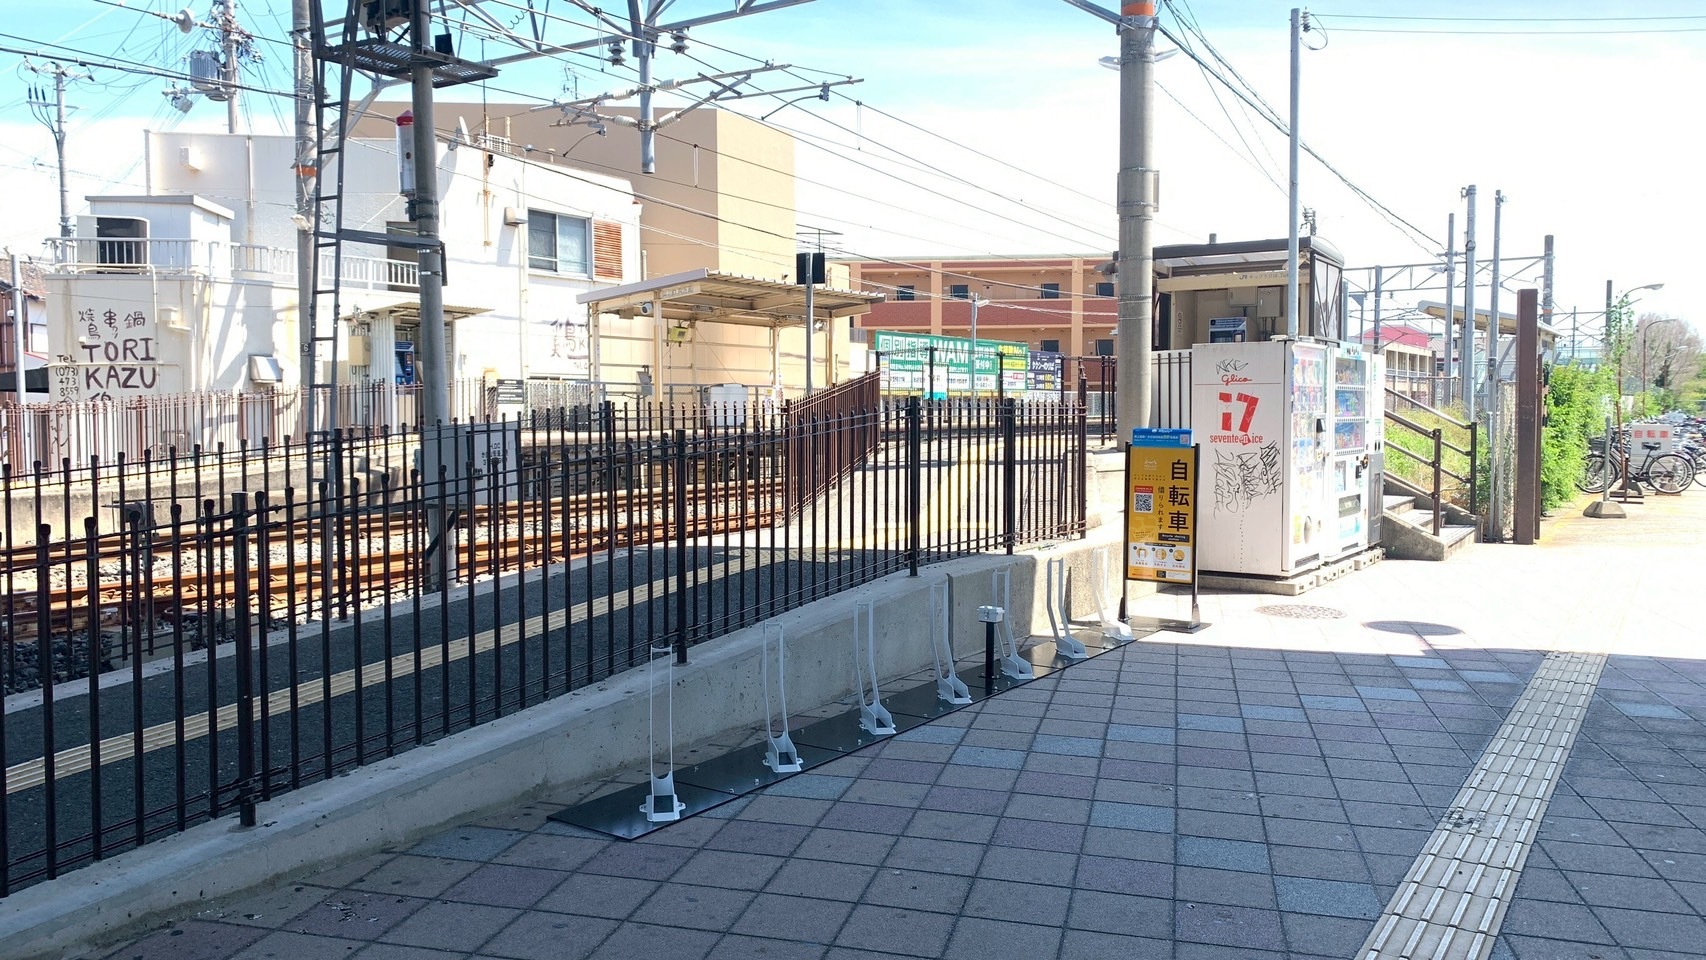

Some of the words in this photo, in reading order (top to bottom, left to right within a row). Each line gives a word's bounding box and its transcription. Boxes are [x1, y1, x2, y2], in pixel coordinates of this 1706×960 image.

[81, 337, 156, 363] TORI
[933, 339, 970, 364] WAM
[55, 366, 79, 377] (073)
[85, 365, 157, 390] KAZU
[58, 377, 77, 385] 473
[1221, 373, 1253, 386] Glico
[60, 386, 80, 397] 8559
[1209, 433, 1251, 446] seventeen
[1251, 434, 1264, 444] ice
[1634, 429, 1669, 439] 自転車
[1168, 458, 1190, 532] 自転車
[1157, 486, 1165, 530] 借りられます
